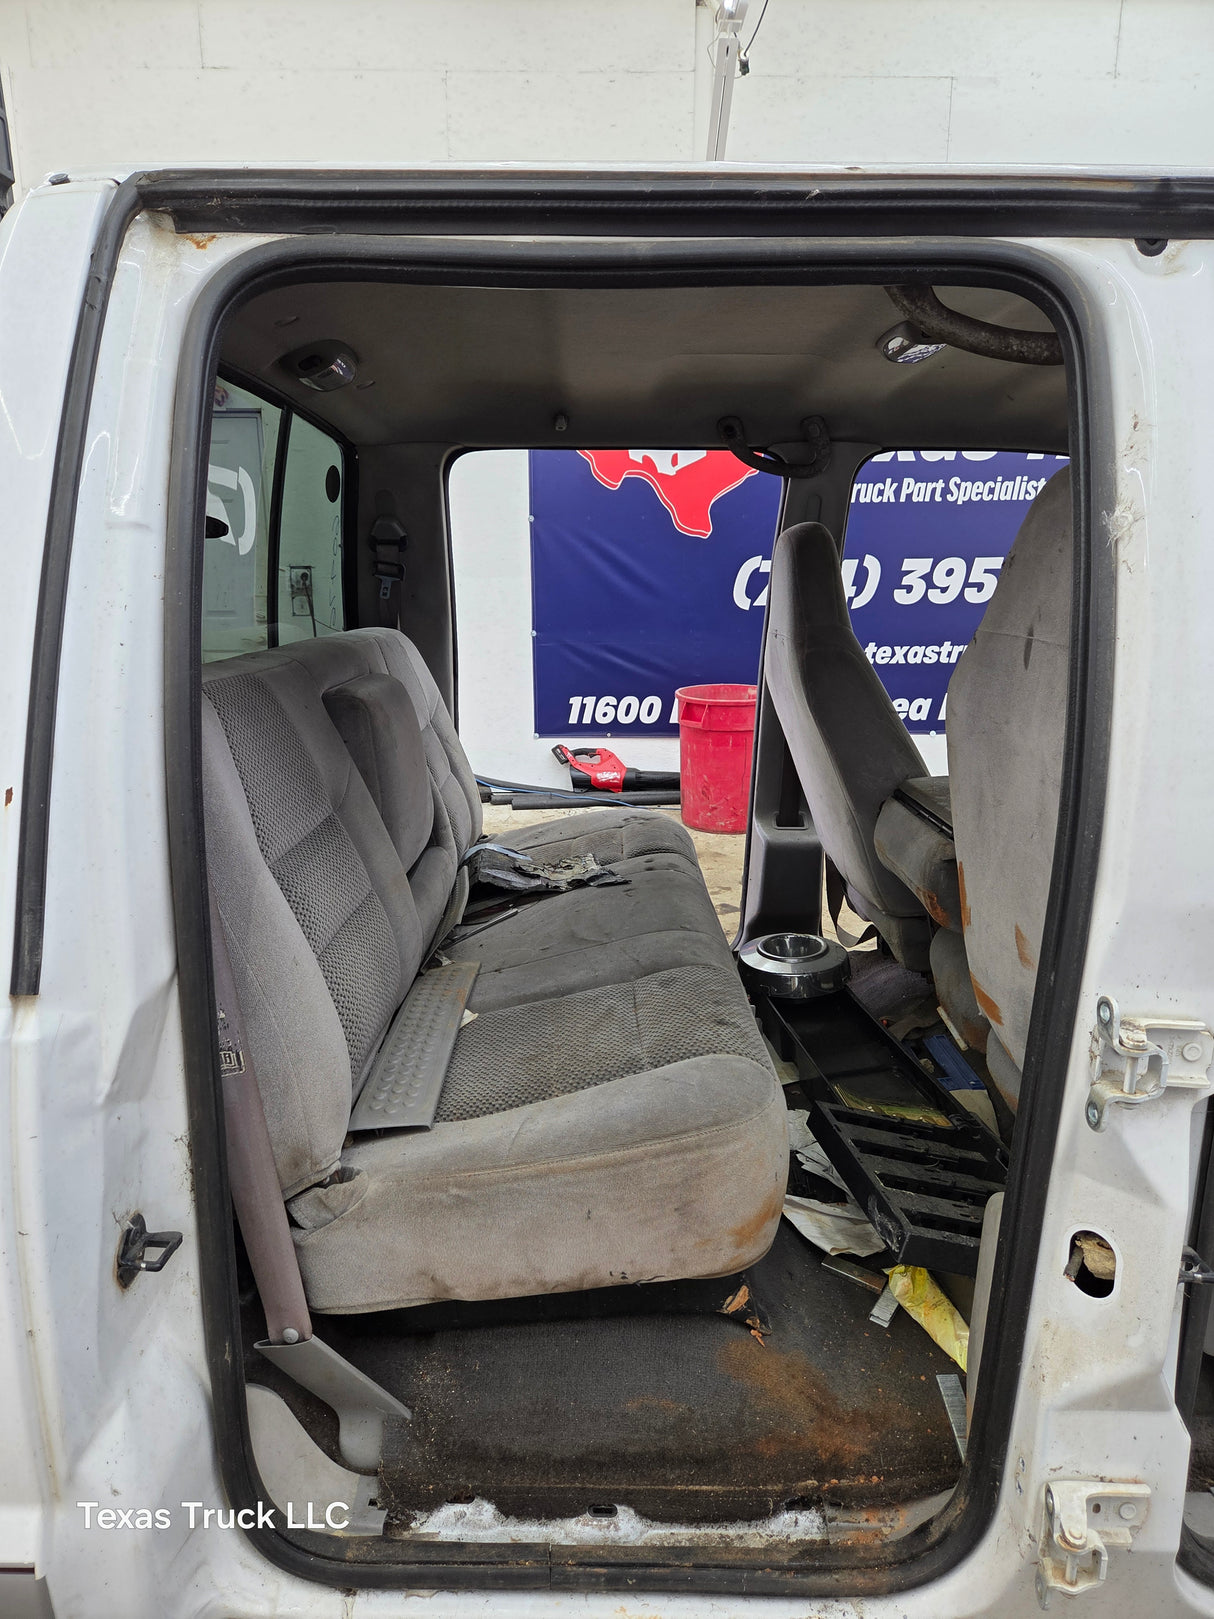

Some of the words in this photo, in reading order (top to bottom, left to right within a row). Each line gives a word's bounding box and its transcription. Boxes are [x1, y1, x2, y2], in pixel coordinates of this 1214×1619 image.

[899, 477, 945, 502] Part
[893, 556, 1005, 605] 395
[864, 641, 968, 664] texastr
[568, 695, 662, 724] 11600
